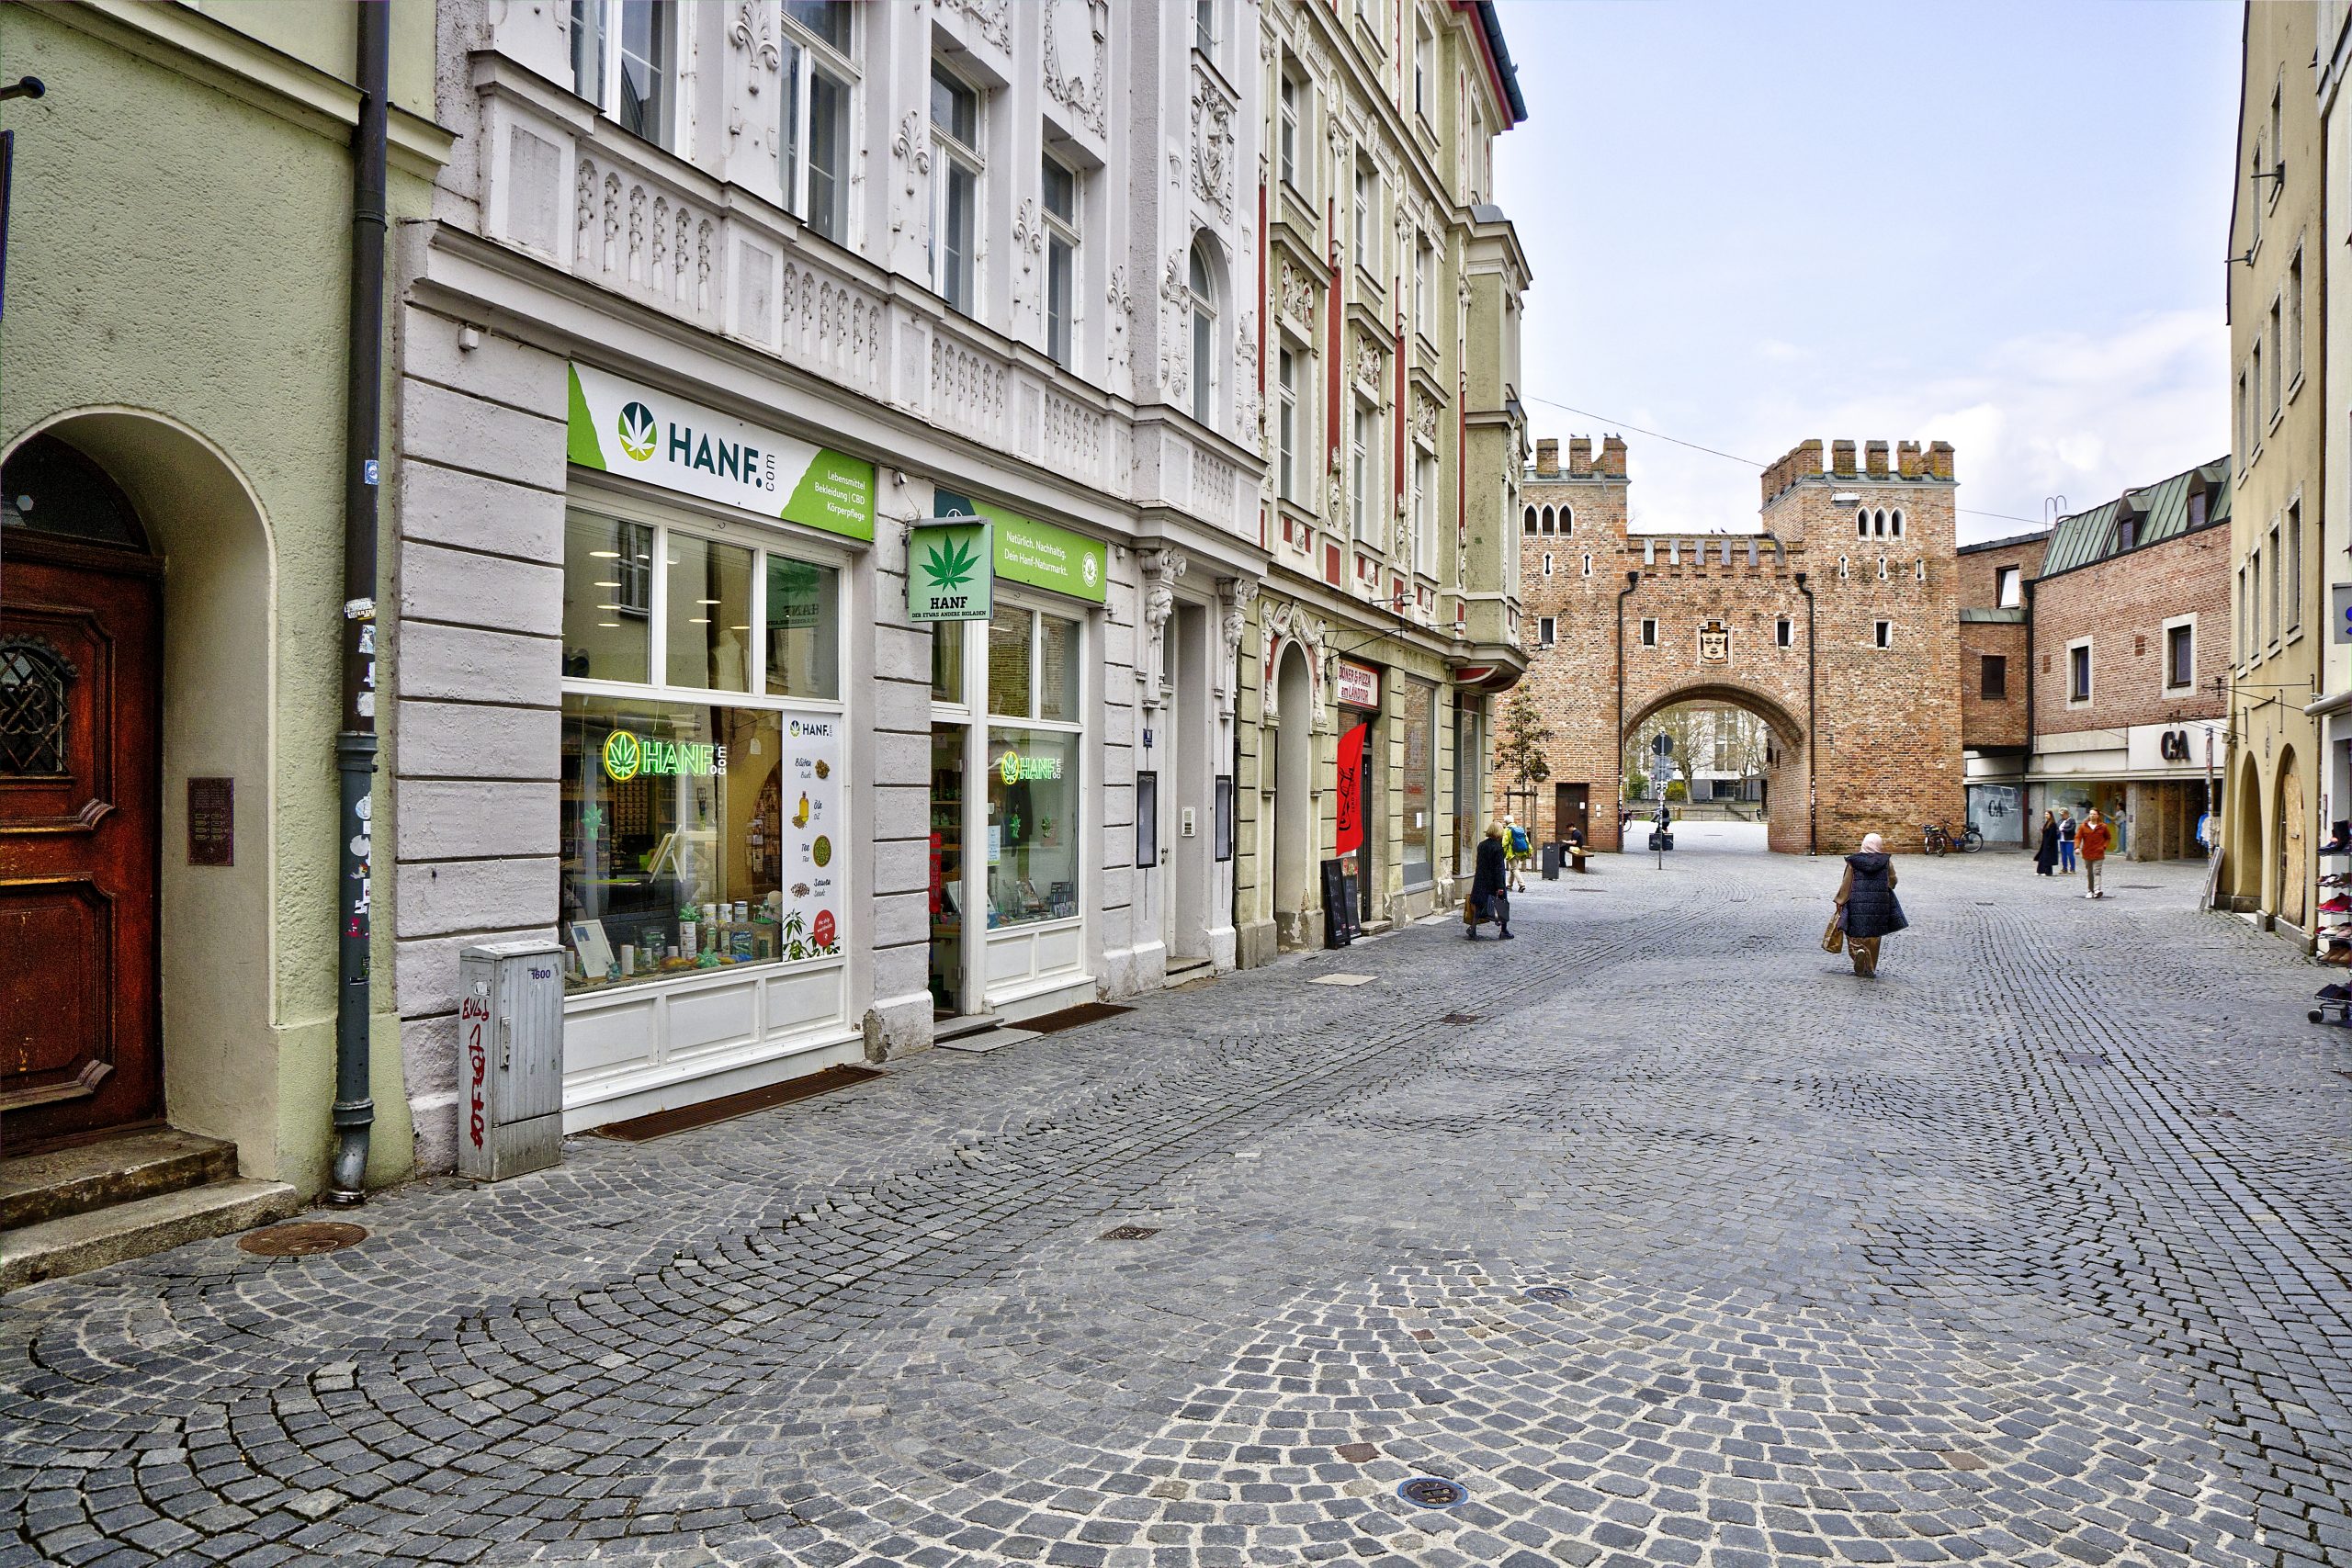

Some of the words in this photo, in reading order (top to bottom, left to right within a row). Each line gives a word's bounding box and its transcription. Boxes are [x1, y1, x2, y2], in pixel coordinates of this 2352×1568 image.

[669, 422, 763, 489] HANF.
[765, 454, 775, 492] com
[828, 469, 865, 491] Lebensmittel
[814, 481, 847, 502] Bekleidung
[851, 493, 865, 505] CBD
[827, 501, 865, 522] Körperpflege
[1006, 530, 1035, 549] Natürlich.
[1035, 539, 1067, 561] Nachhaltig.
[1004, 547, 1019, 562] Dein
[1019, 552, 1069, 577] Hanf-Naturmarkt.
[930, 596, 968, 610] HANF
[1339, 663, 1353, 683] DÖNER
[1358, 671, 1371, 688] PIZZA
[802, 723, 829, 737] HANF.
[801, 843, 810, 852] Tee
[531, 969, 551, 980] 1600
